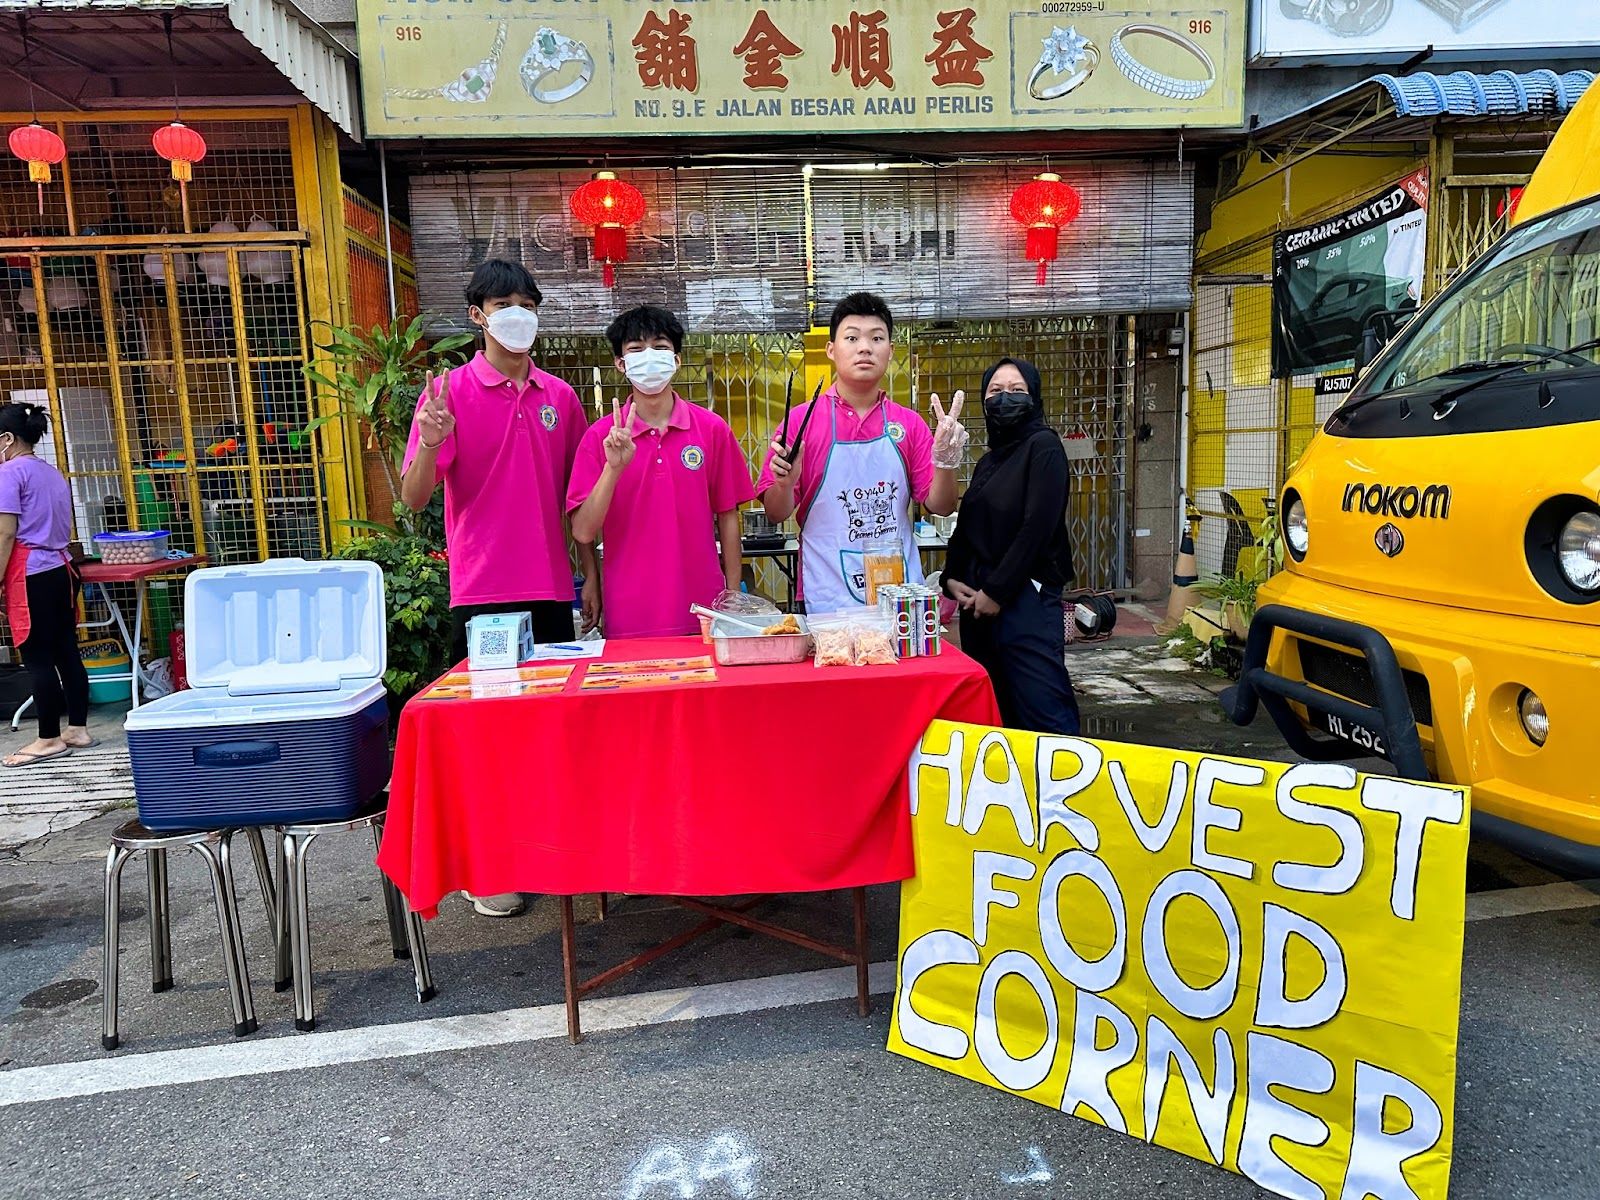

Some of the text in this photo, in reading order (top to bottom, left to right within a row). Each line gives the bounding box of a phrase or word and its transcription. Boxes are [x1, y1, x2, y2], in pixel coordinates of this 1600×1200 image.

[1042, 1, 1105, 13] 000272959-U
[395, 26, 422, 41] 916
[1188, 19, 1212, 34] 916
[634, 99, 667, 118] NO.
[716, 98, 782, 117] JALAN
[791, 97, 856, 116] BESAR
[864, 97, 916, 115] ARAU
[926, 95, 994, 114] PERLIS
[1400, 218, 1423, 232] TINTED
[1359, 233, 1376, 248] 50%
[909, 730, 1464, 921] HARVEST
[972, 848, 1347, 1029] FOOD
[897, 929, 1444, 1200] CORNER
